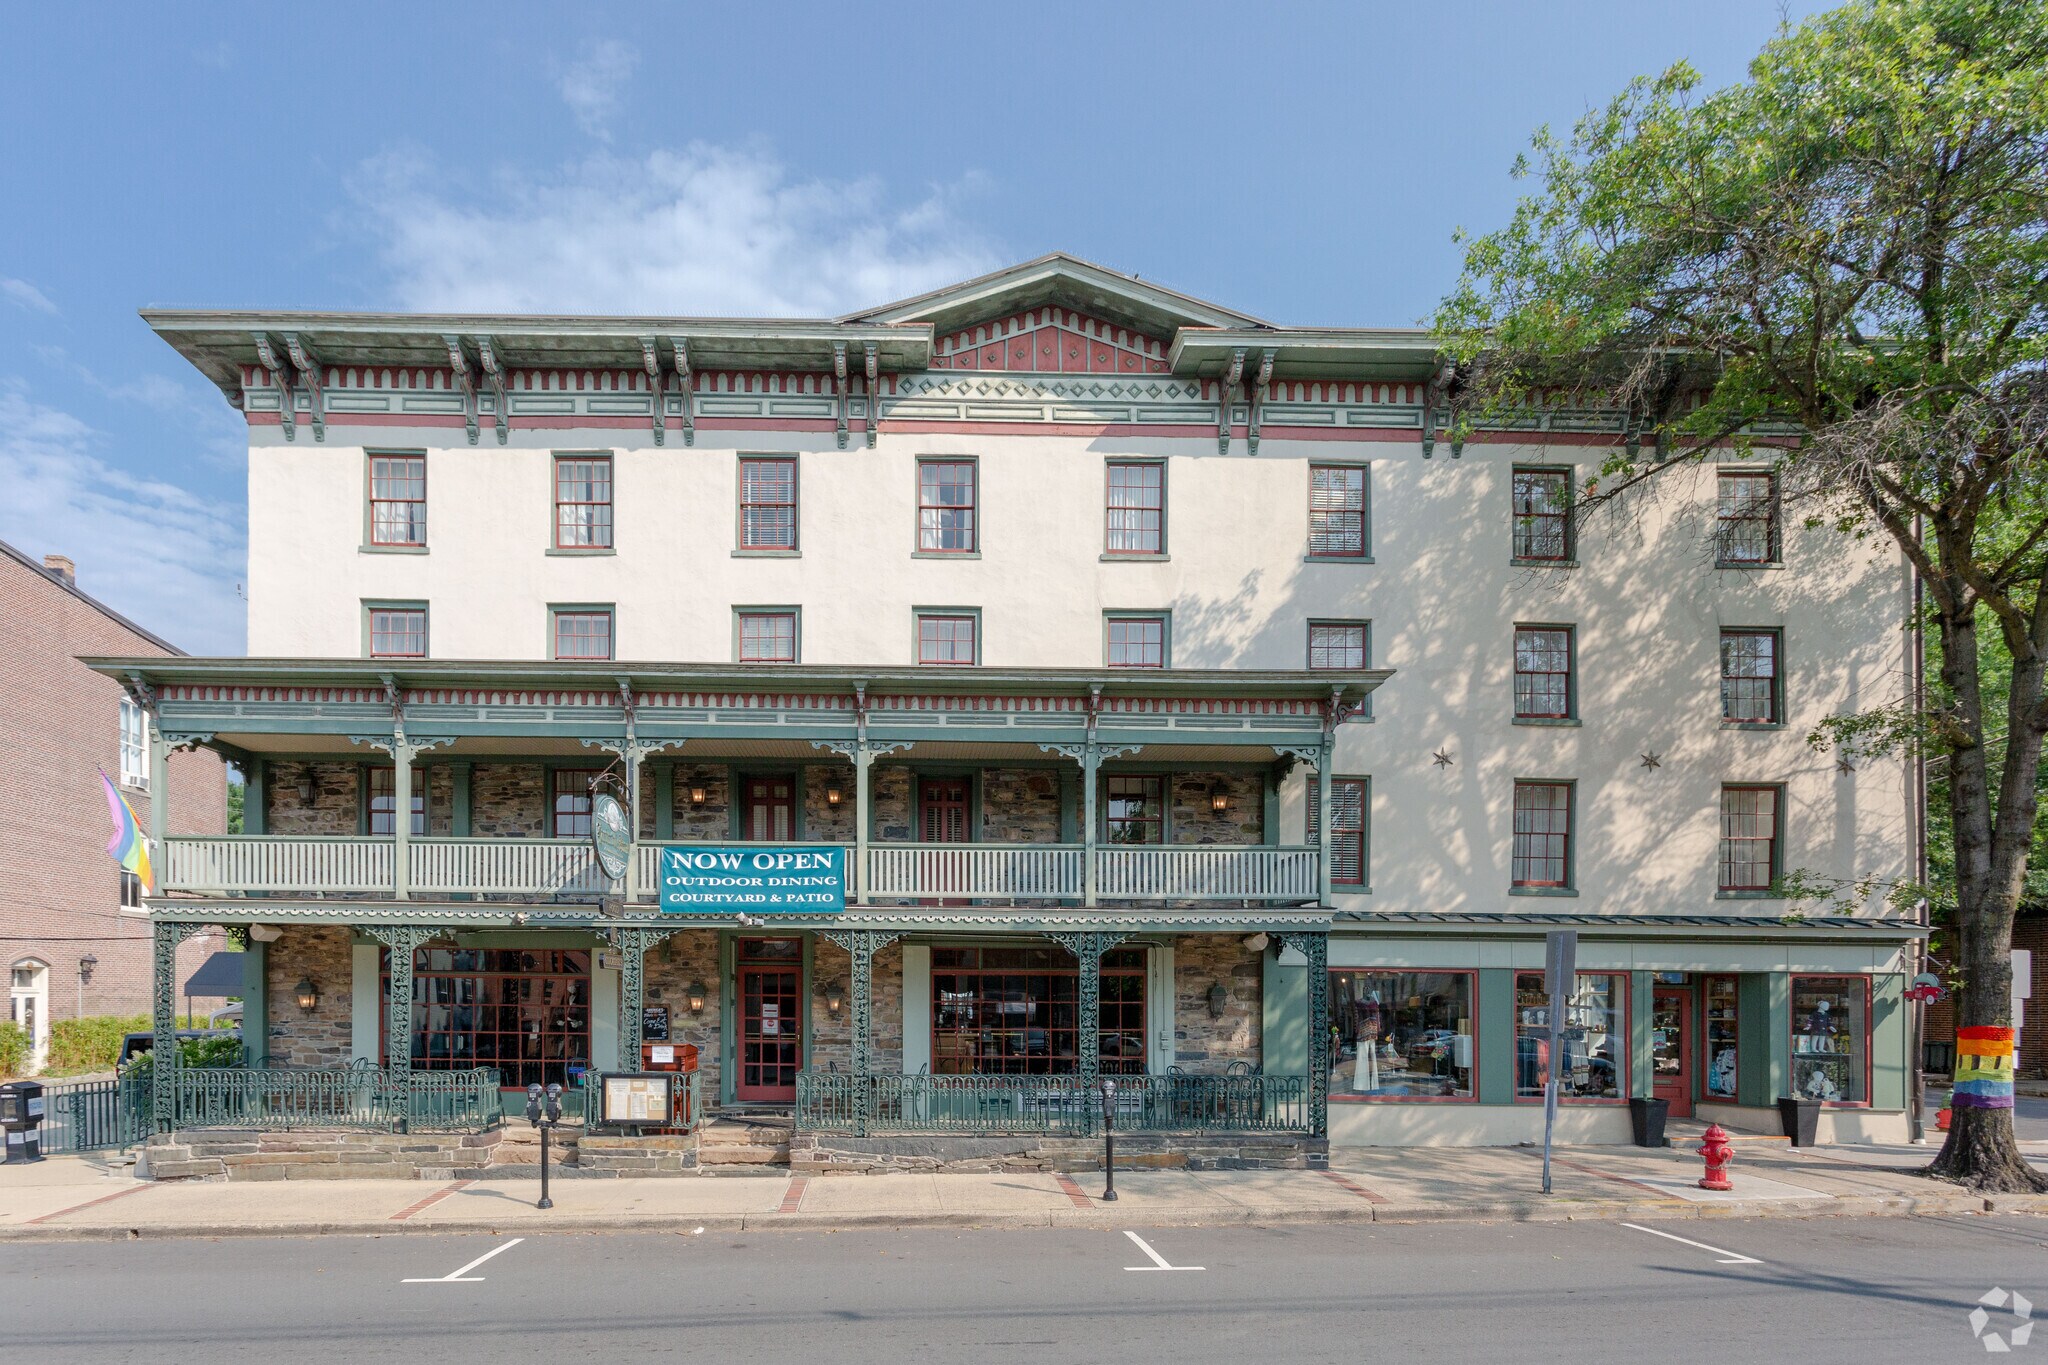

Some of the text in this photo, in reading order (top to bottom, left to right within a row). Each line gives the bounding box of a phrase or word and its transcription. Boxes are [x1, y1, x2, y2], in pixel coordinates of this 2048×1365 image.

[672, 853, 834, 870] NOW OPEN
[666, 876, 838, 887] OUTDOOR DINING
[669, 893, 834, 903] COURTYARD & PATIO
